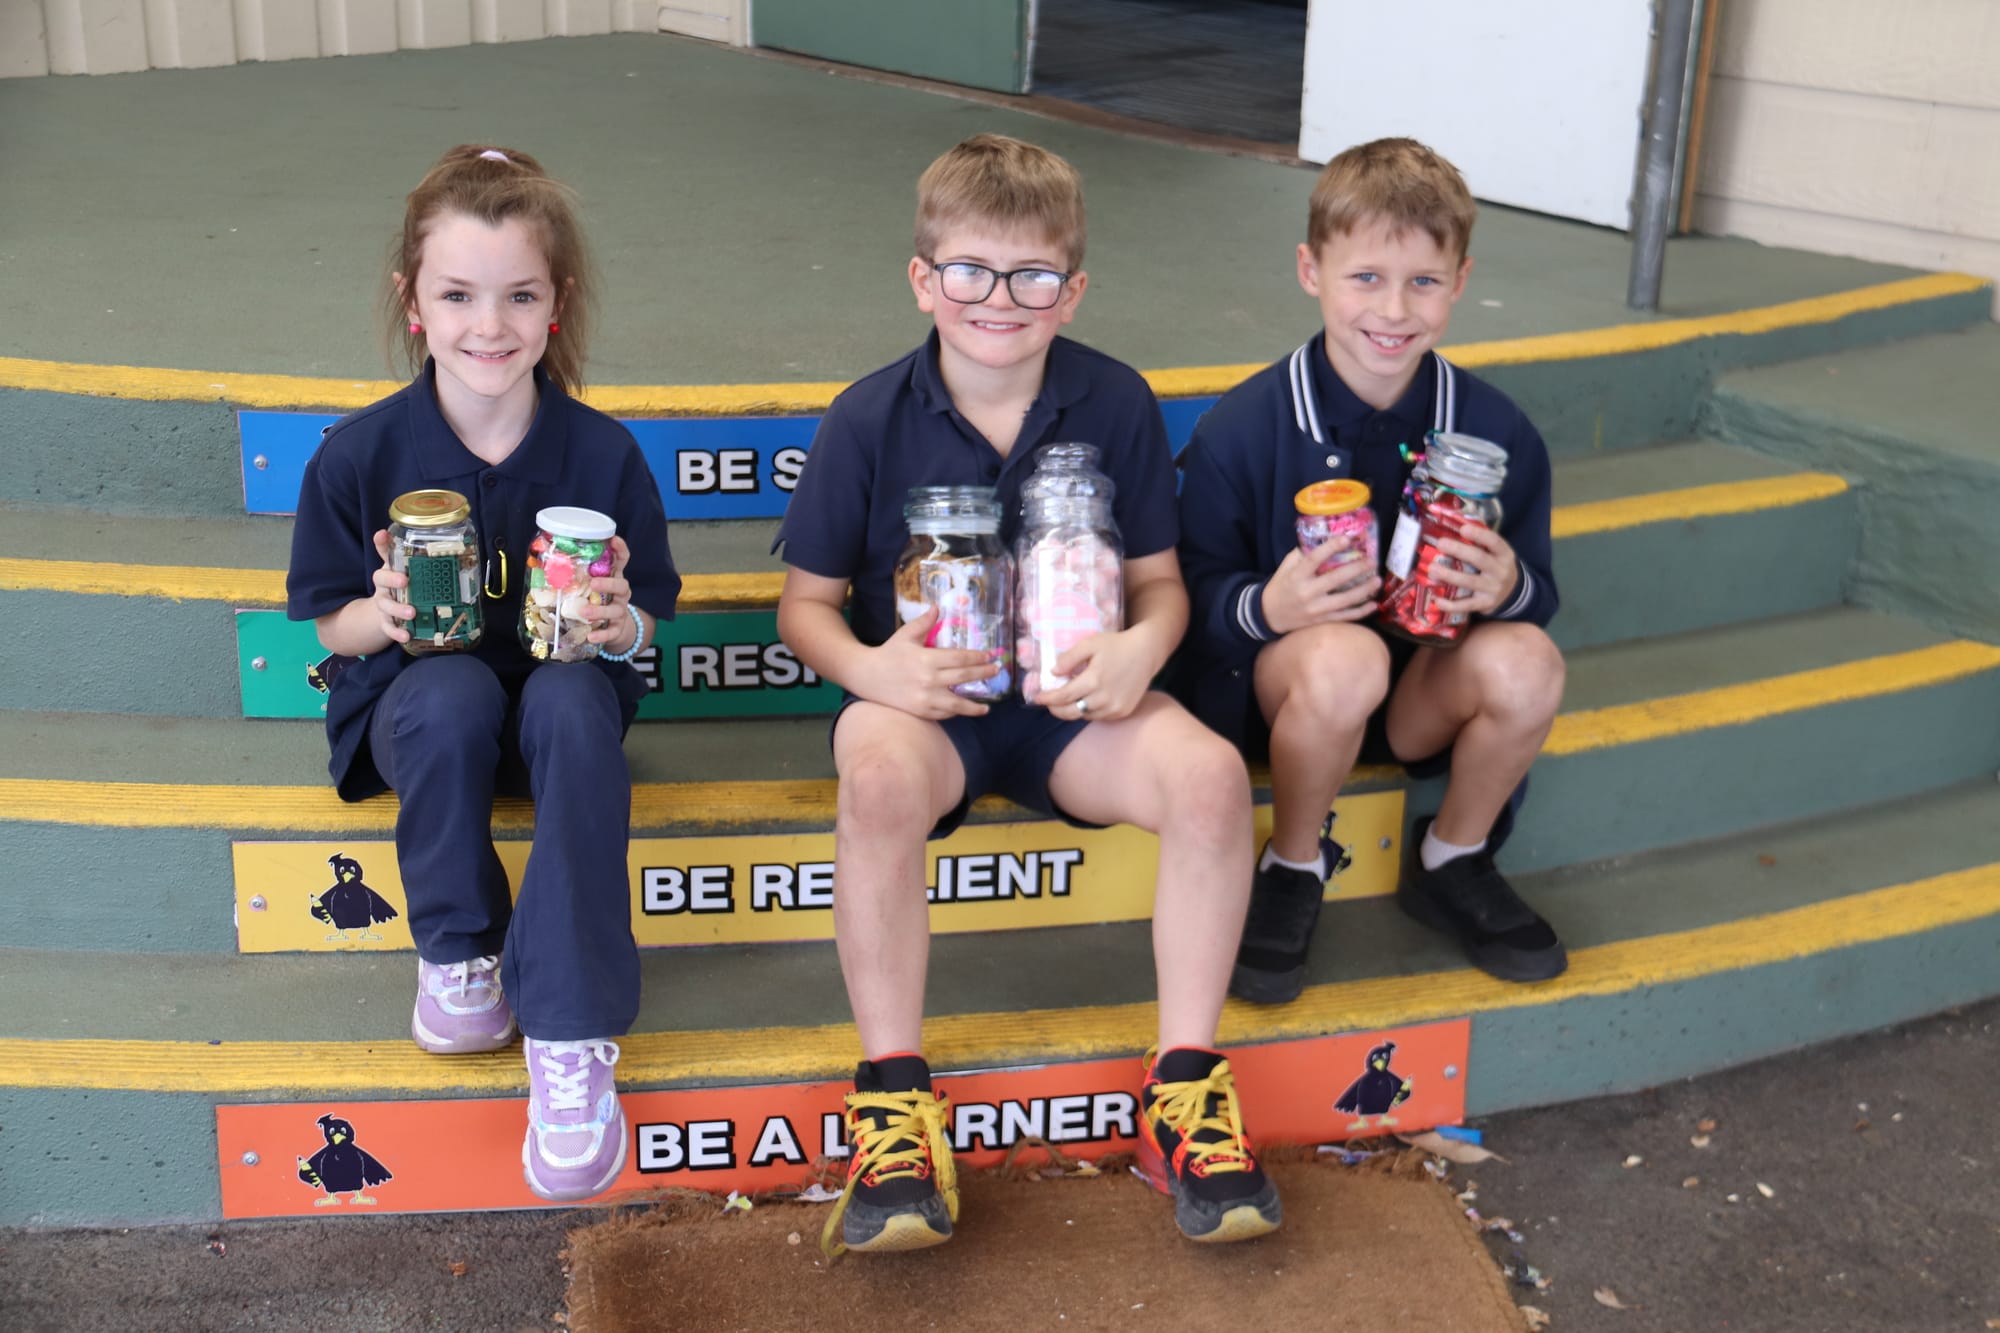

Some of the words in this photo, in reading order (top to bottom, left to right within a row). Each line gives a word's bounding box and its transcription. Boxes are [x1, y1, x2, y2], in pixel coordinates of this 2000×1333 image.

[677, 448, 759, 495] BE
[770, 447, 808, 493] S
[630, 645, 665, 692] E
[641, 864, 735, 916] BE
[750, 848, 1084, 912] REIENT
[635, 1118, 736, 1173] BE
[748, 1115, 808, 1167] A
[820, 1091, 1138, 1159] LRNER
